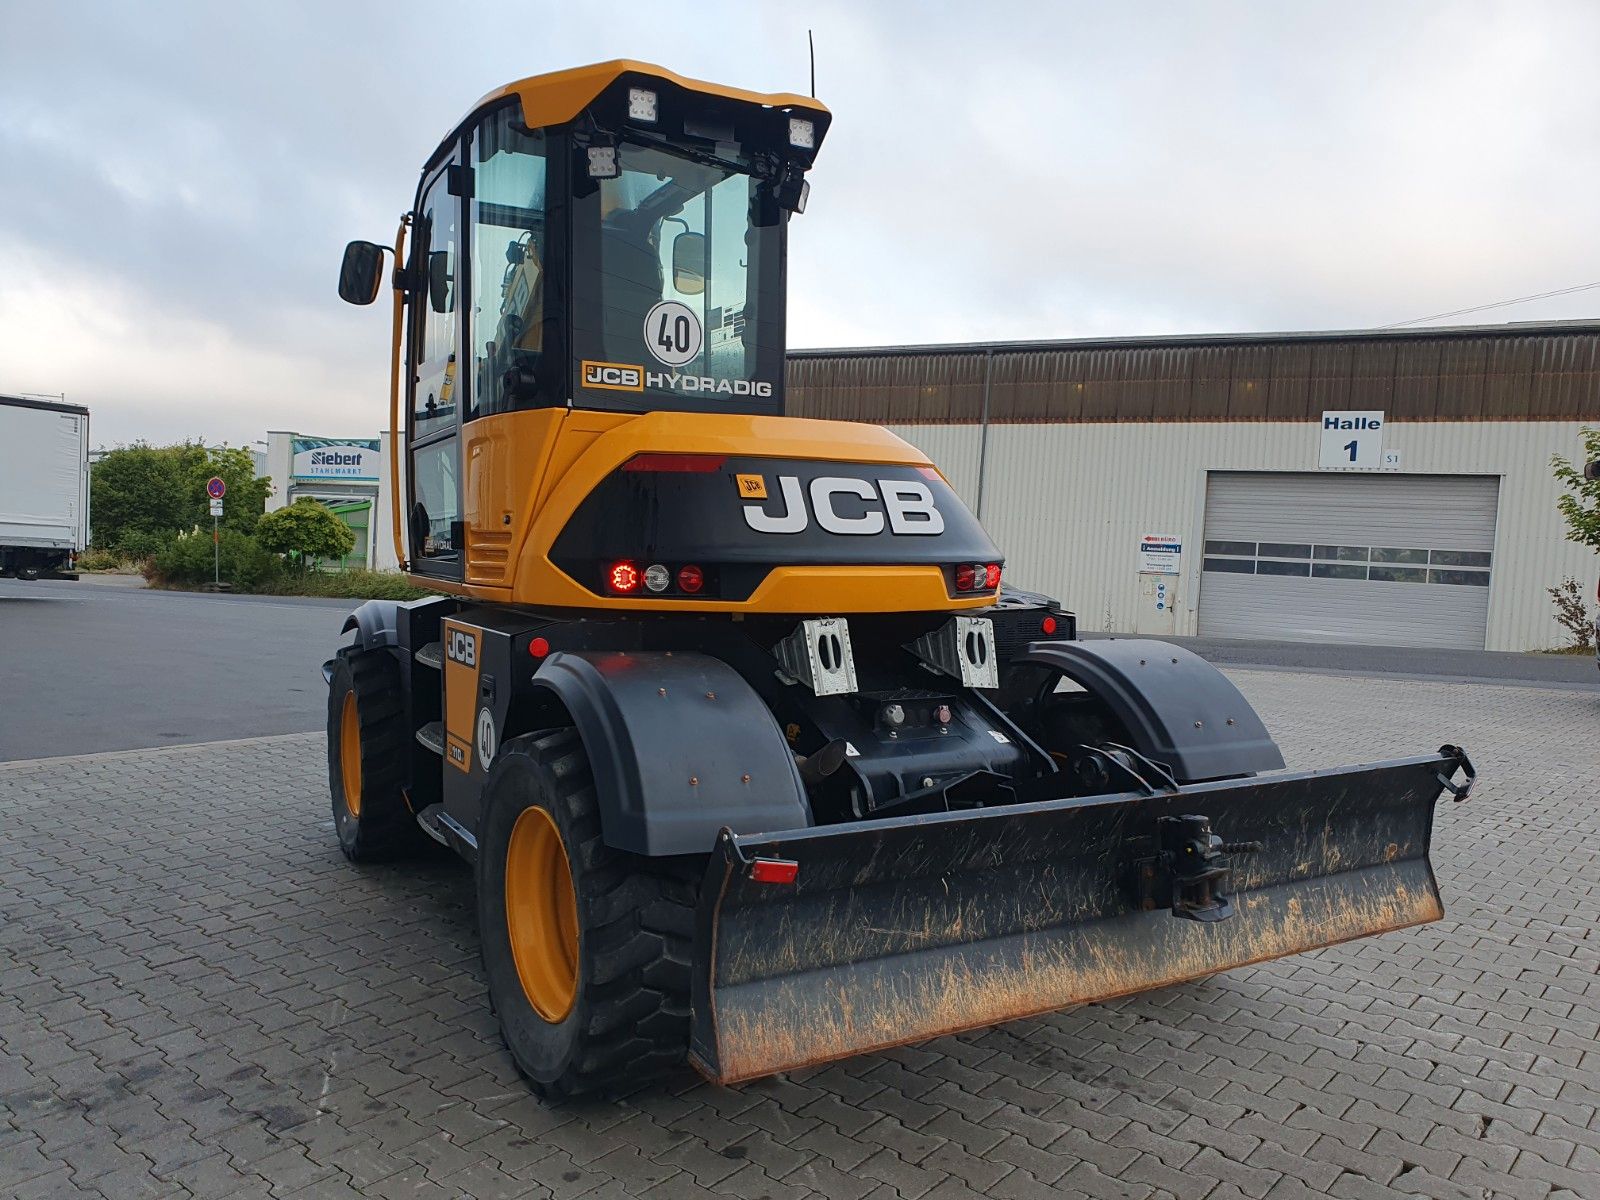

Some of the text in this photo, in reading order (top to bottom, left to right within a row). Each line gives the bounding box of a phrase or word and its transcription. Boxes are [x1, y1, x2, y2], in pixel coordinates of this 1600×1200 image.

[657, 313, 690, 353] 40
[587, 367, 772, 397] JCB HYDRADIG
[1324, 417, 1381, 430] Halle
[311, 451, 362, 465] Siebert
[1344, 440, 1357, 461] 1
[744, 480, 761, 491] JCB
[743, 476, 945, 534] JCB
[447, 630, 476, 666] JCB
[481, 720, 492, 760] 40
